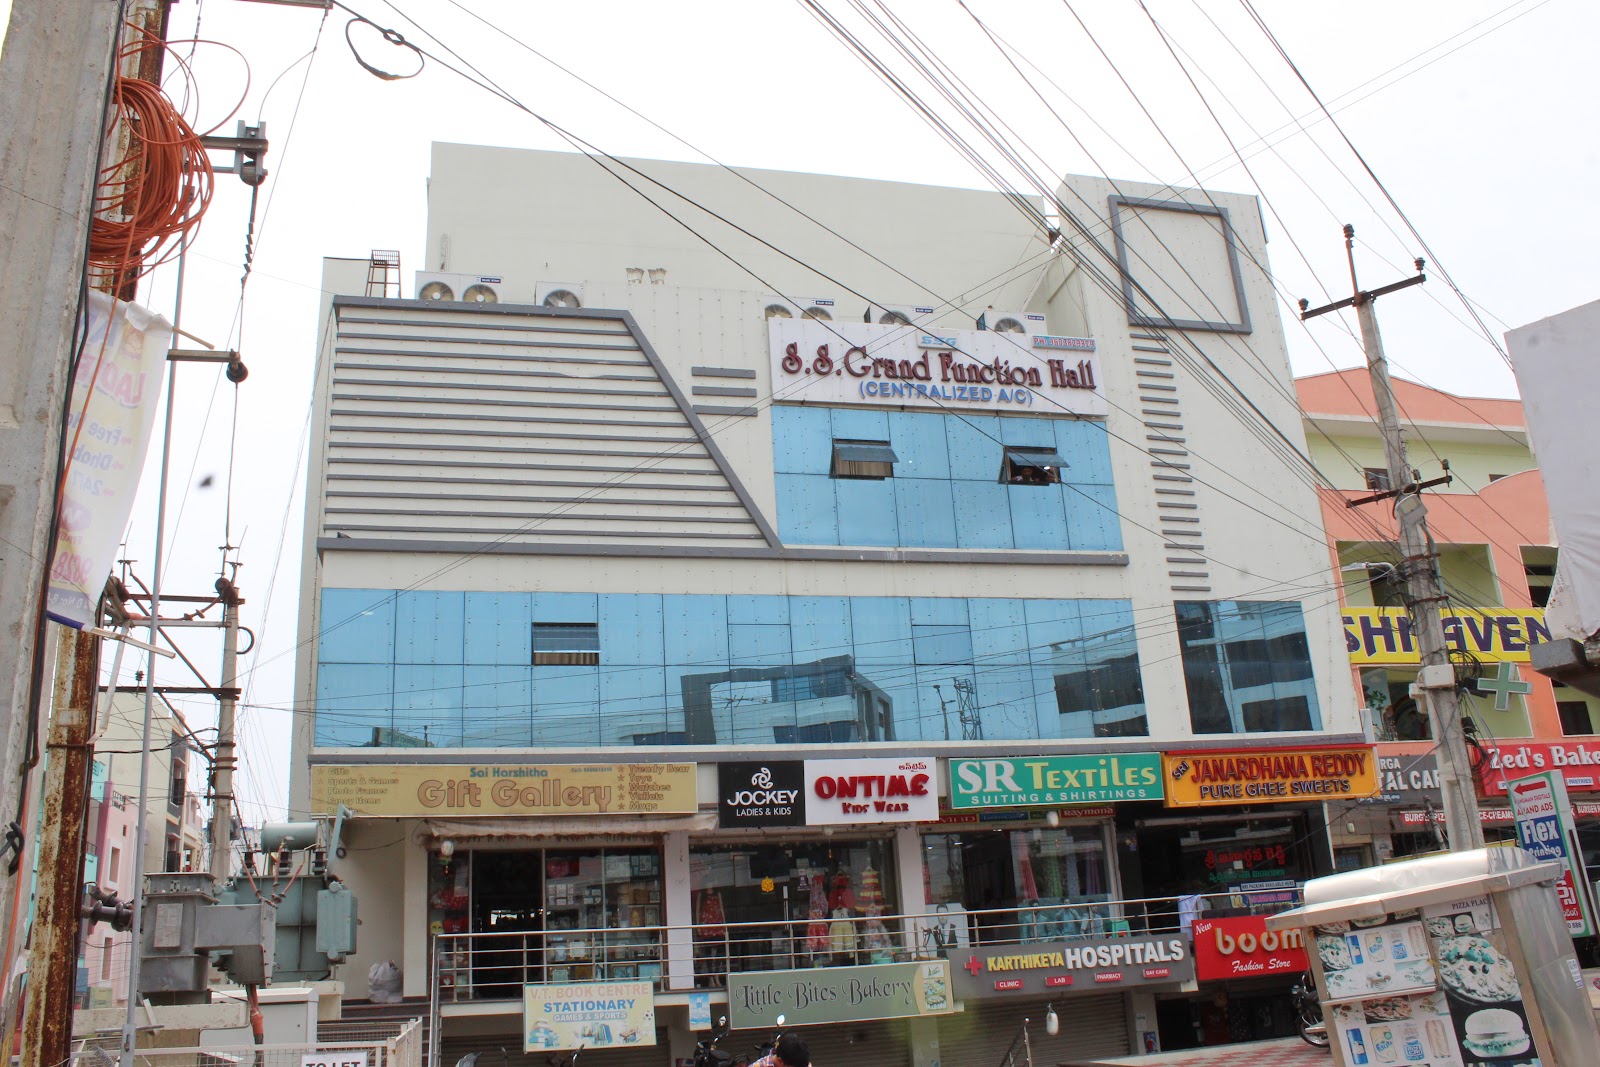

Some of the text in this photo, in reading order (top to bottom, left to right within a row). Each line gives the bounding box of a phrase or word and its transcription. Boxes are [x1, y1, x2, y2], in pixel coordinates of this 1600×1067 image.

[921, 335, 957, 348] SSG
[939, 351, 1043, 387] Function
[1047, 359, 1097, 390] Hall
[1486, 746, 1545, 769] Zed's
[469, 767, 548, 778] Sai Harshitha
[667, 764, 690, 773] Bear
[1172, 761, 1190, 780] SRI
[1190, 753, 1367, 783] JANARDHANA REDDY
[328, 777, 357, 786] Sports
[368, 777, 399, 785] Games
[629, 774, 652, 783] Toys
[957, 760, 1022, 795] SR
[328, 787, 353, 795] Photo
[629, 783, 671, 791] Watches
[814, 773, 930, 799] ONTIME
[1200, 779, 1350, 799] PURE GHEE SWEETS
[417, 778, 612, 813] Gift Gallery
[726, 790, 799, 805] JOCKEY
[971, 789, 1147, 805] SUITING & SHIRTINGS
[629, 801, 658, 811] Mugs
[736, 807, 792, 816] LADIES & KIDS
[1541, 802, 1553, 812] ADS
[1520, 819, 1560, 845] Flex
[1452, 898, 1491, 910] PIZZA PLAC
[1195, 922, 1212, 935] New
[1215, 927, 1304, 955] boom
[987, 939, 1185, 972] KARTHIKEYA HOSPITALS
[1156, 968, 1168, 976] CARE
[1231, 958, 1291, 973] Fashion Store
[1096, 972, 1122, 980] PHARMACY
[999, 980, 1020, 988] CLINIC
[530, 984, 649, 1000] V.T. BOOK CENTRE
[735, 983, 781, 1014] Little
[787, 981, 837, 1009] Bites
[841, 976, 912, 1005] Bakery
[543, 998, 636, 1013] STATIONARY
[554, 1011, 628, 1022] GAMES & SPORTS
